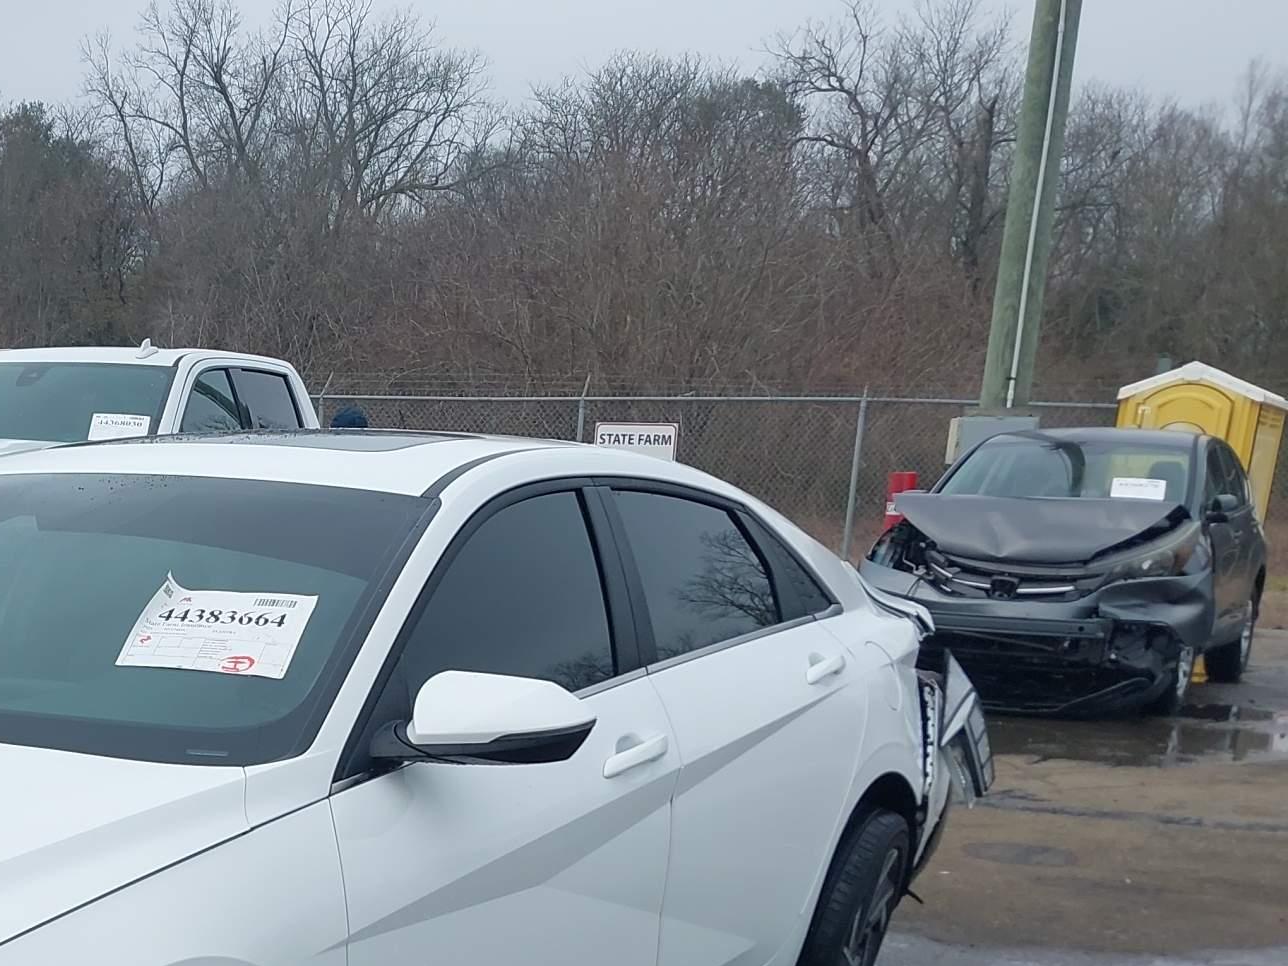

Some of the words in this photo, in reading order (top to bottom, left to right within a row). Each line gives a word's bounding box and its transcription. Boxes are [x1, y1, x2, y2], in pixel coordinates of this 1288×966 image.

[599, 433, 635, 445] STATE
[637, 433, 672, 445] FARM
[158, 607, 287, 628] 44383664
